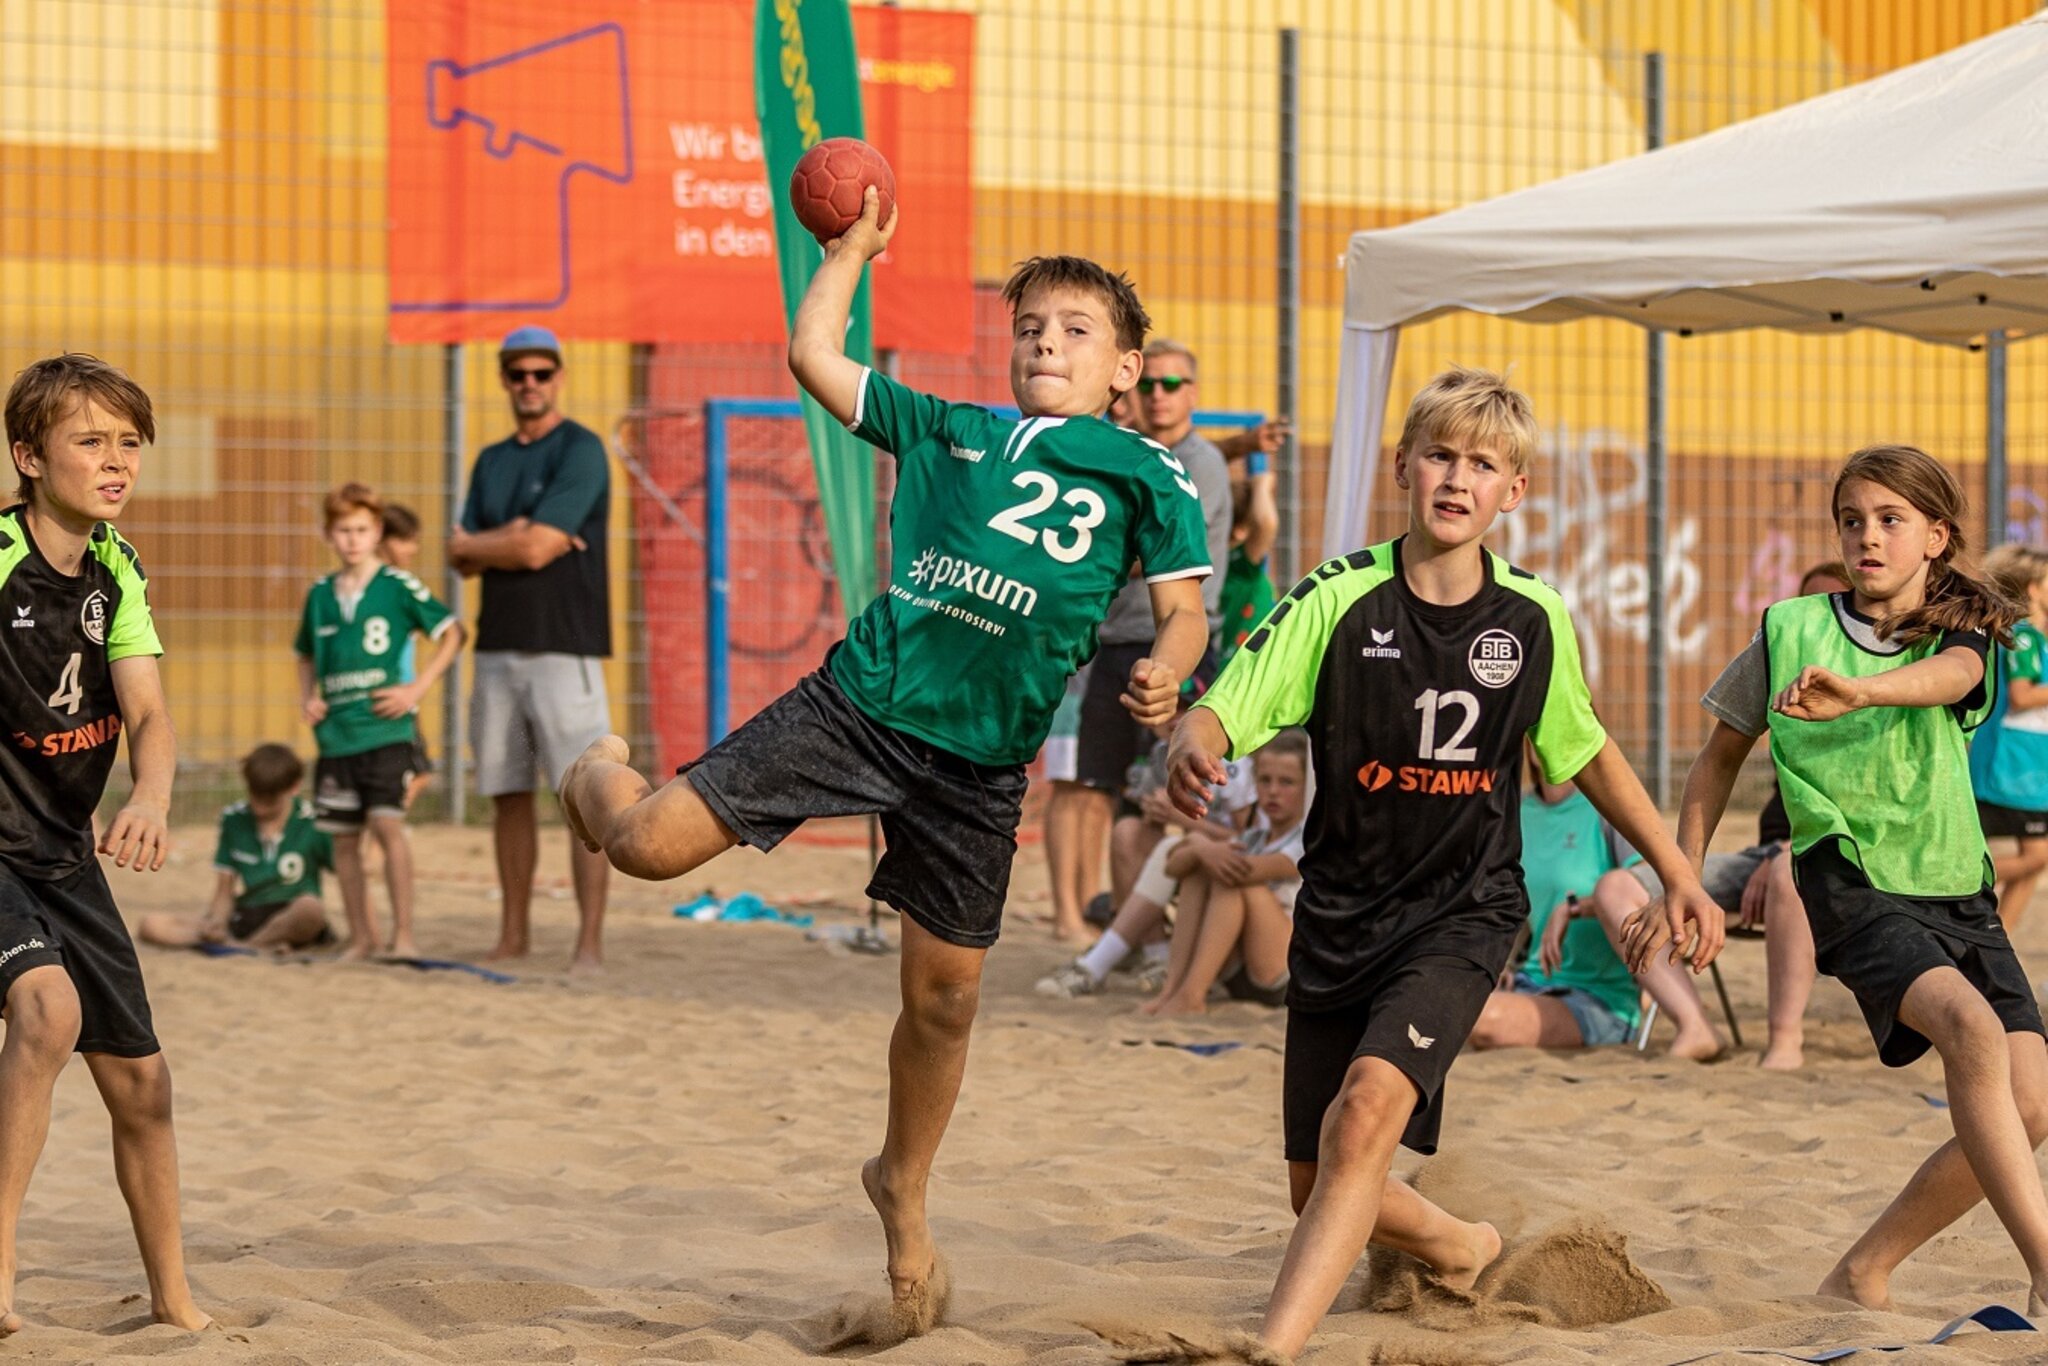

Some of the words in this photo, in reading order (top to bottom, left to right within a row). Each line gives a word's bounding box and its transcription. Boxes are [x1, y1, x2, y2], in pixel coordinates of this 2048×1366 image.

[670, 122, 726, 159] Wir
[675, 218, 707, 256] in
[711, 218, 772, 257] den
[987, 471, 1107, 564] 23
[928, 555, 1038, 617] pixum
[362, 616, 391, 655] 8
[1362, 645, 1401, 659] erima
[1481, 637, 1513, 659] BTB
[48, 652, 83, 715] 4
[1477, 662, 1514, 671] AACHEN
[1414, 688, 1480, 762] 12
[1399, 766, 1497, 795] STAWA
[277, 852, 304, 885] 9
[0, 938, 45, 966] chen.de
